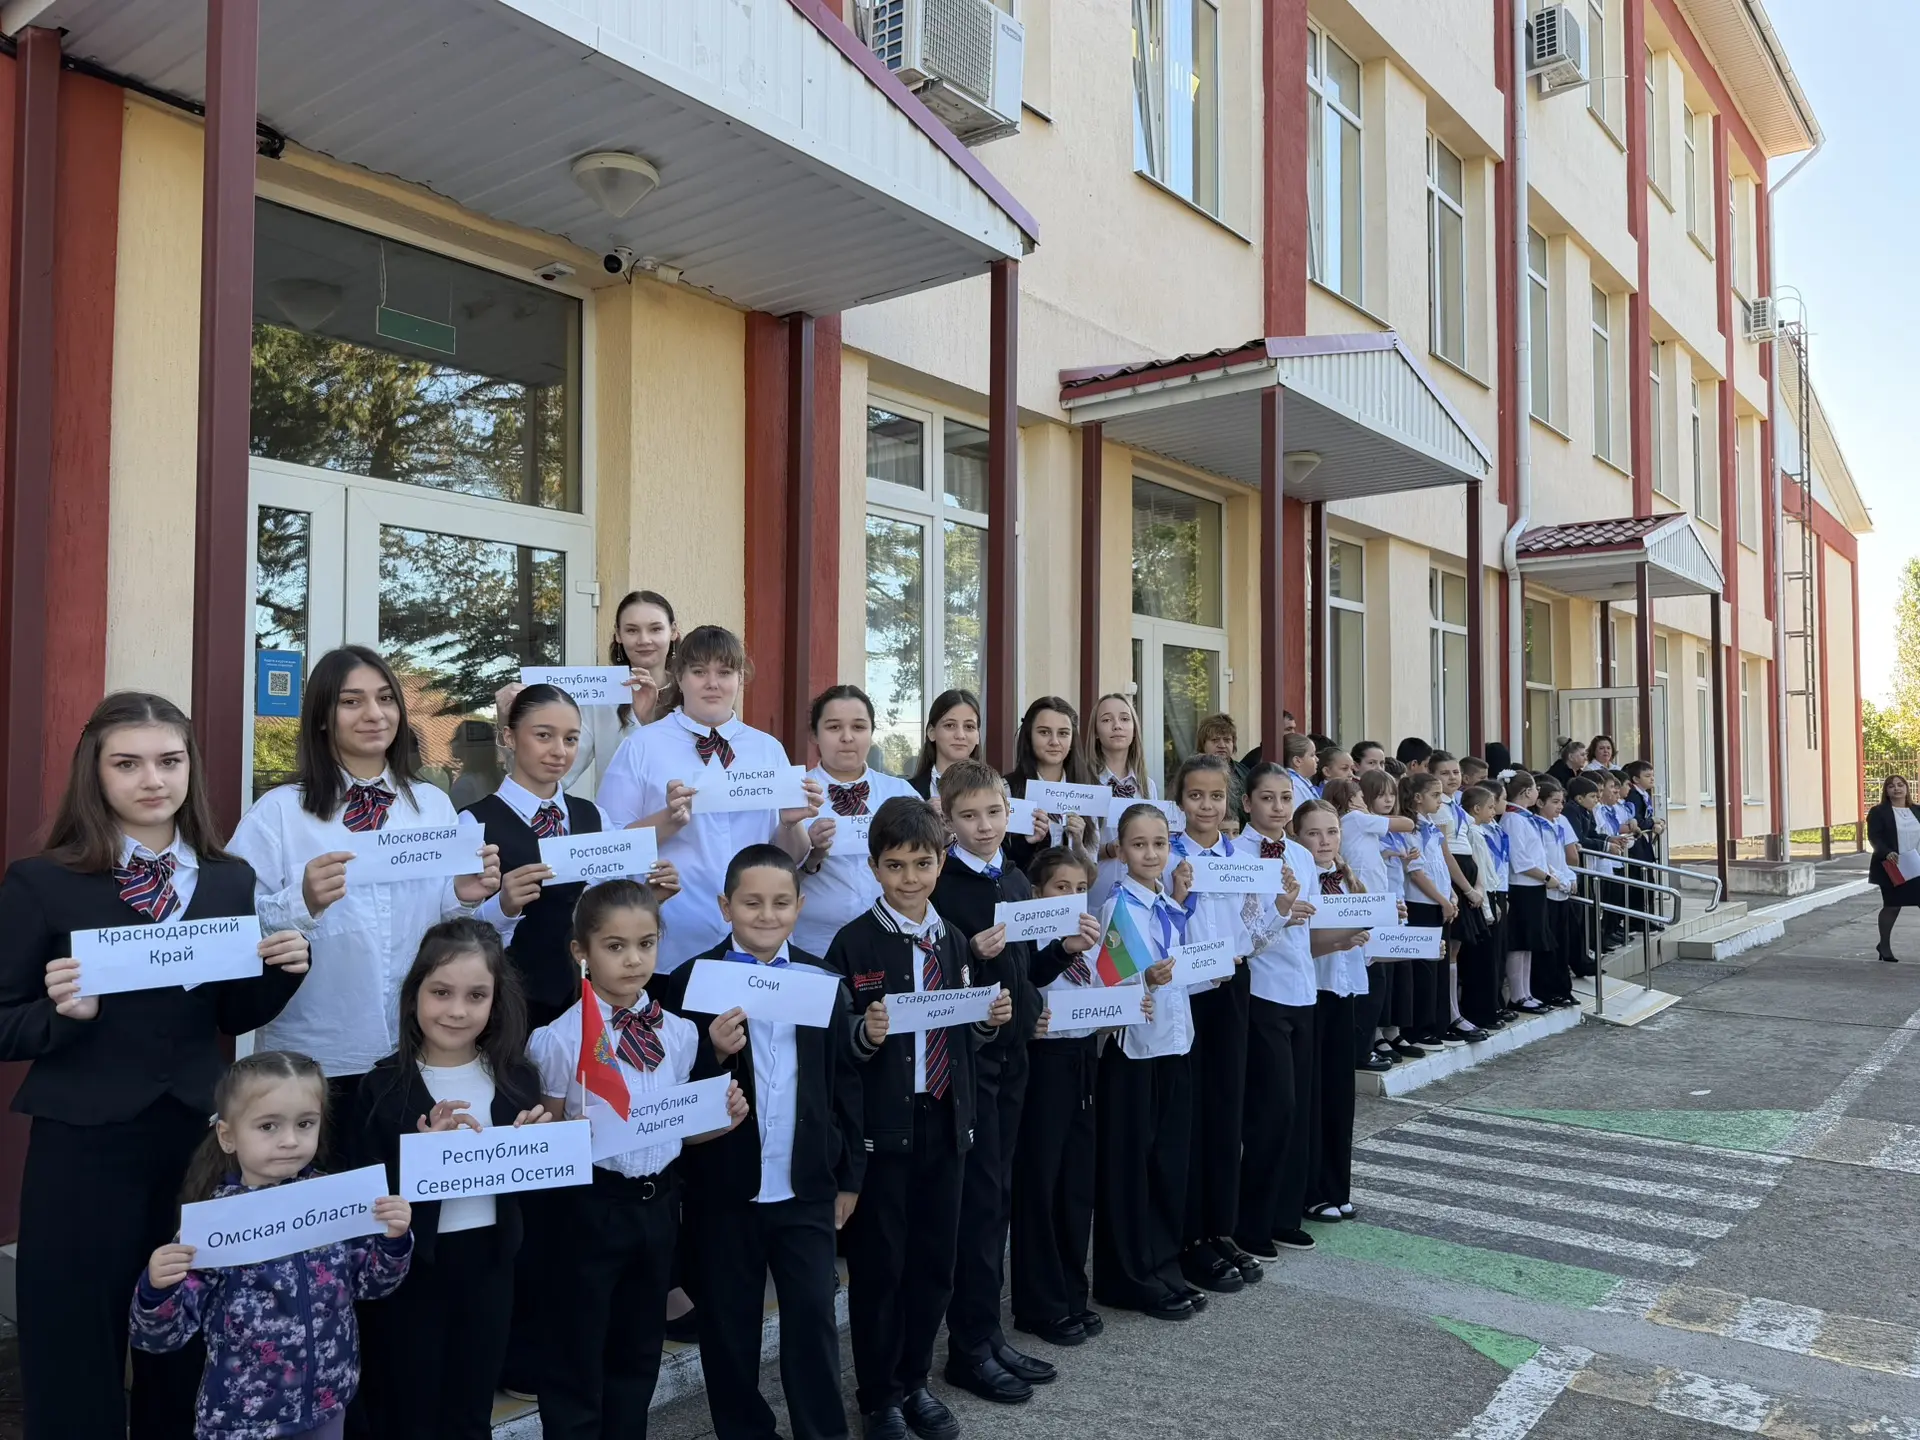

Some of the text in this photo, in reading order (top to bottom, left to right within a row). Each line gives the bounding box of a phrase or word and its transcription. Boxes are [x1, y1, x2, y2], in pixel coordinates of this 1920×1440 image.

[546, 674, 608, 686] Республика
[571, 689, 605, 699] рий Эл
[726, 770, 775, 782] Тульская
[729, 786, 774, 798] область
[1045, 788, 1095, 800] Республика
[1056, 802, 1081, 812] Крым
[378, 828, 457, 846] Московская
[391, 850, 442, 865] область
[570, 842, 632, 859] Ростовская
[580, 862, 625, 877] область
[1208, 861, 1264, 872] Сахалинская
[1219, 873, 1255, 882] область
[1322, 895, 1386, 905] Волгоградская
[1014, 907, 1070, 923] Саратовская
[1338, 907, 1372, 917] область
[98, 918, 239, 946] Краснодарский
[1021, 925, 1058, 937] область
[1379, 932, 1433, 945] Оренбургская
[1182, 940, 1225, 956] Астраханская
[1389, 945, 1420, 954] область
[150, 946, 194, 966] Край
[1191, 958, 1217, 970] область
[748, 975, 780, 991] Сочи
[896, 987, 992, 1005] Ставропольский
[927, 1006, 955, 1019] край
[1071, 1005, 1123, 1020] БЕРАНДА
[636, 1114, 684, 1135] Адыгея
[442, 1141, 549, 1165] Республика
[416, 1164, 575, 1195] Северная Осетия
[207, 1201, 368, 1248] Омская область
